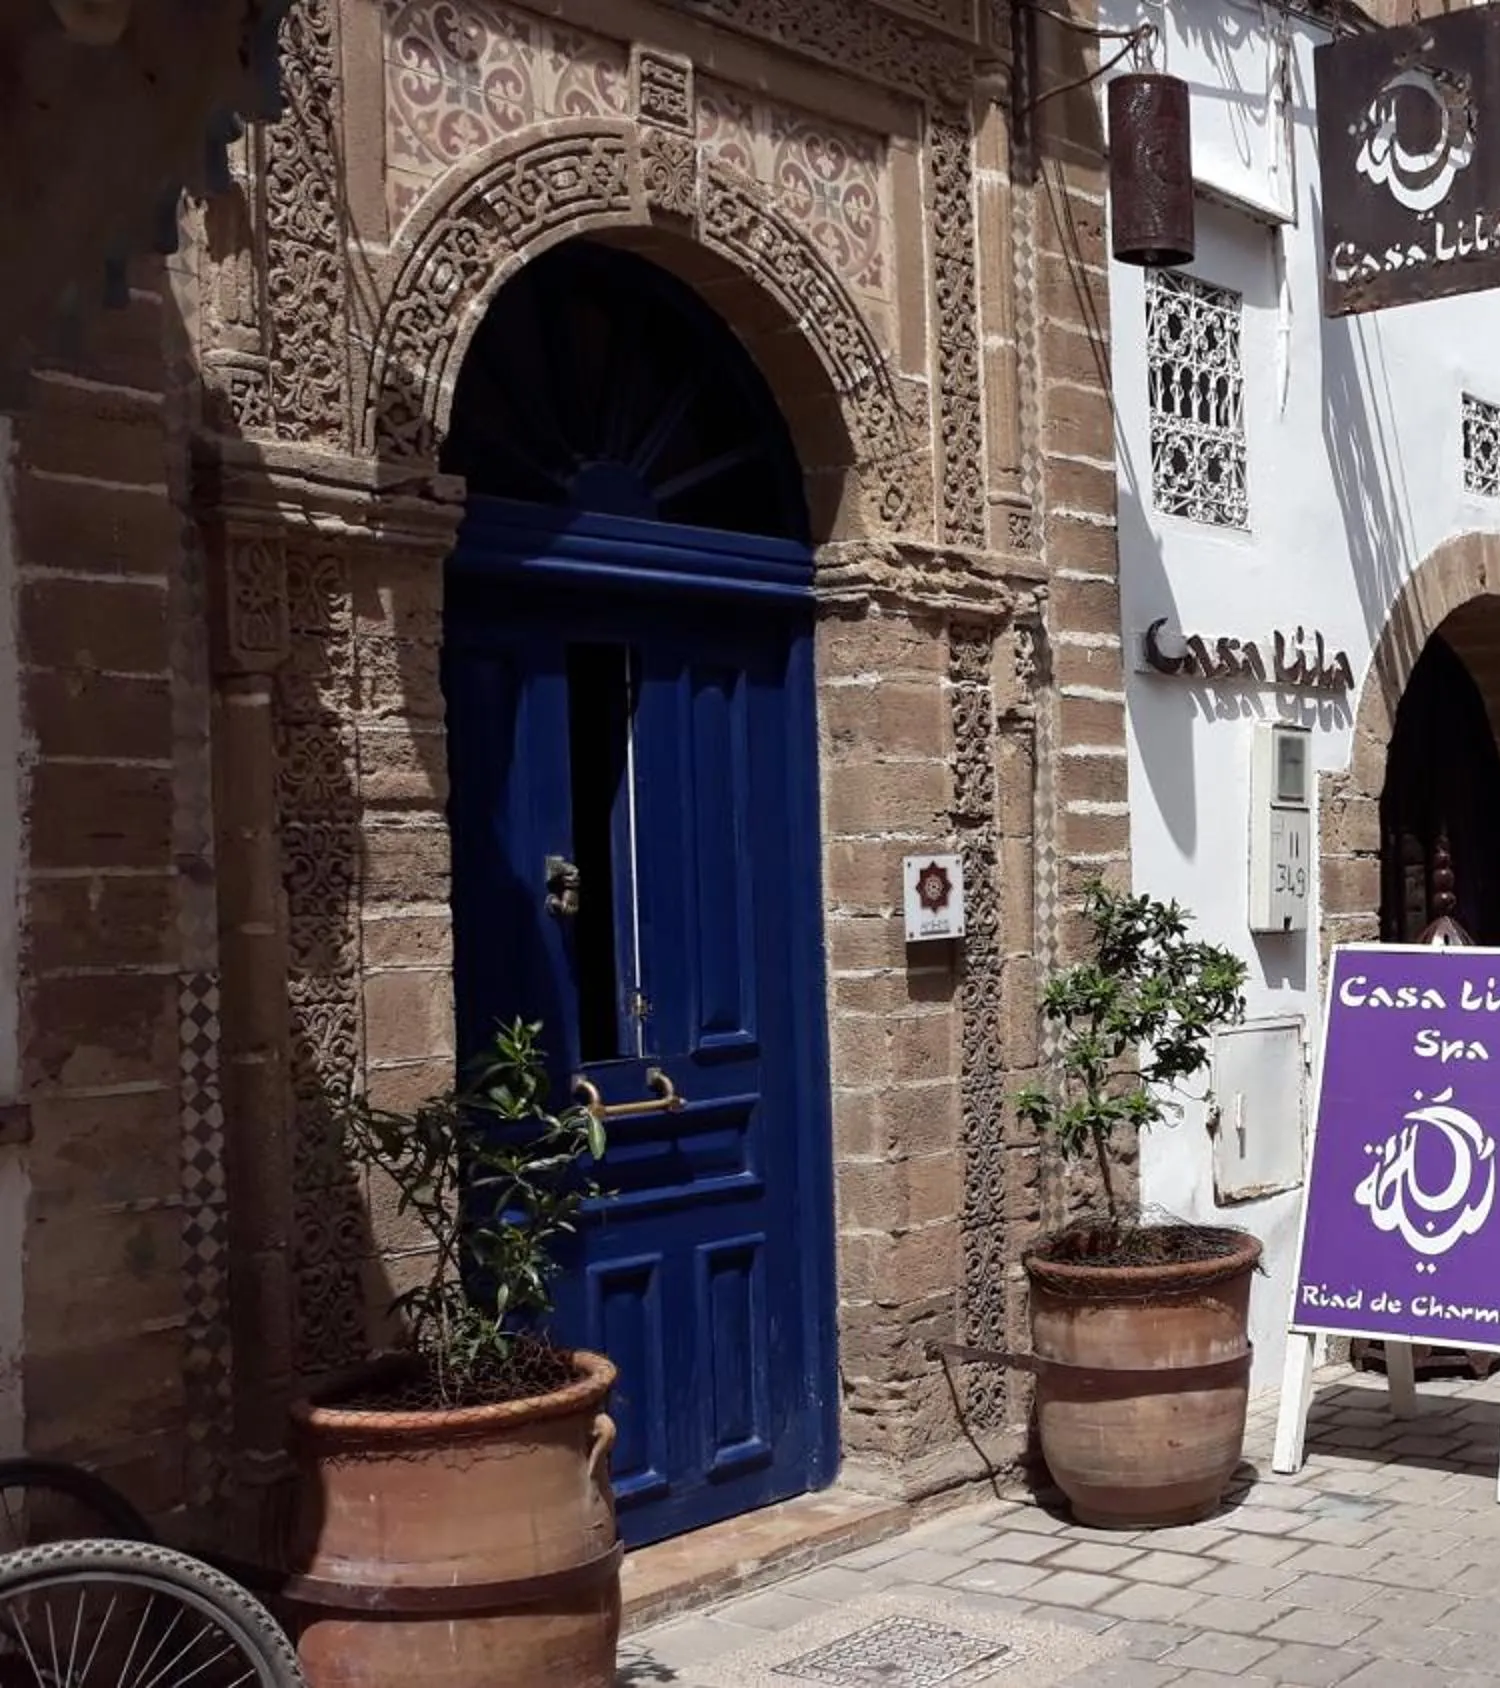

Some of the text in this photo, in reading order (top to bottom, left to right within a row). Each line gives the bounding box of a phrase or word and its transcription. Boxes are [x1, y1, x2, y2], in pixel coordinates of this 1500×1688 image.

[1329, 241, 1426, 281] Casa
[1144, 616, 1354, 690] Casa Lila
[1340, 976, 1446, 1010] Casa
[1414, 1029, 1489, 1063] Spa
[1303, 1283, 1362, 1311] Riad
[1370, 1292, 1402, 1314] de
